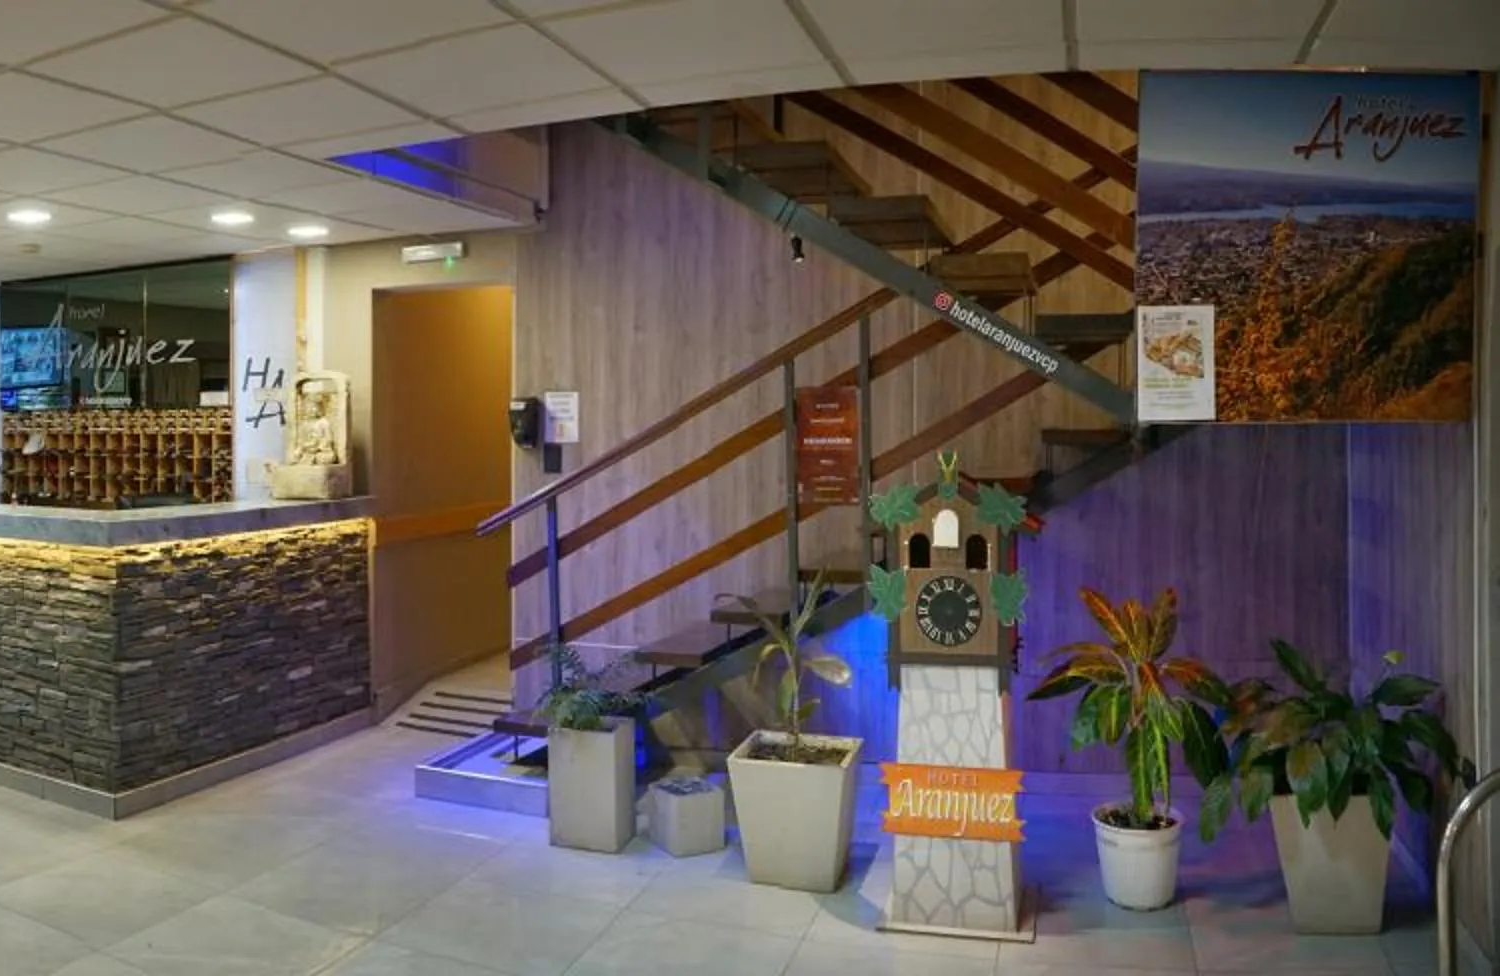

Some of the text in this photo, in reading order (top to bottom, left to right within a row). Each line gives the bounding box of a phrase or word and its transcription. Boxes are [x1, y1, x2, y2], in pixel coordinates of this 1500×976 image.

[1293, 95, 1467, 162] Aranjuez
[30, 303, 197, 393] Aranjuez
[889, 778, 1015, 837] Aranjuez
[927, 769, 979, 787] HOTEL
